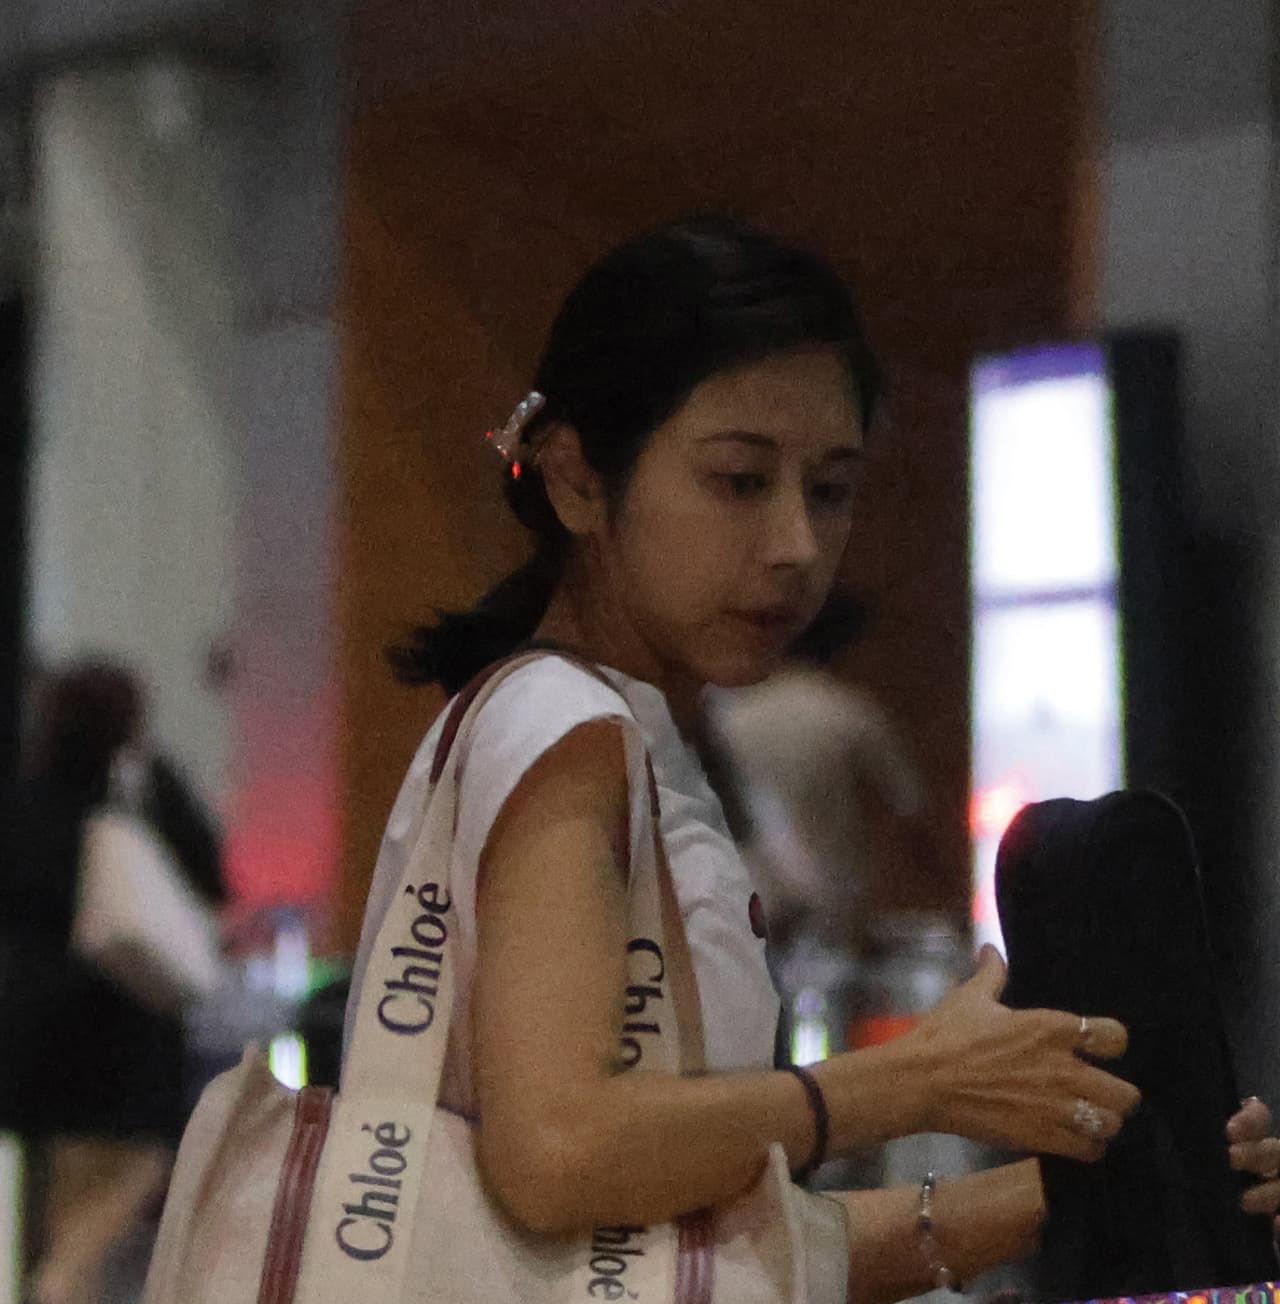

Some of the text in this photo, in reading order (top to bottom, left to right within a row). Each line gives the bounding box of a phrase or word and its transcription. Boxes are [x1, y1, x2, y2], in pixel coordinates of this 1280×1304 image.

[377, 882, 451, 1035] Chloé
[616, 937, 665, 1070] Chlo
[335, 1121, 411, 1261] Chloé
[587, 1223, 646, 1301] hloé
